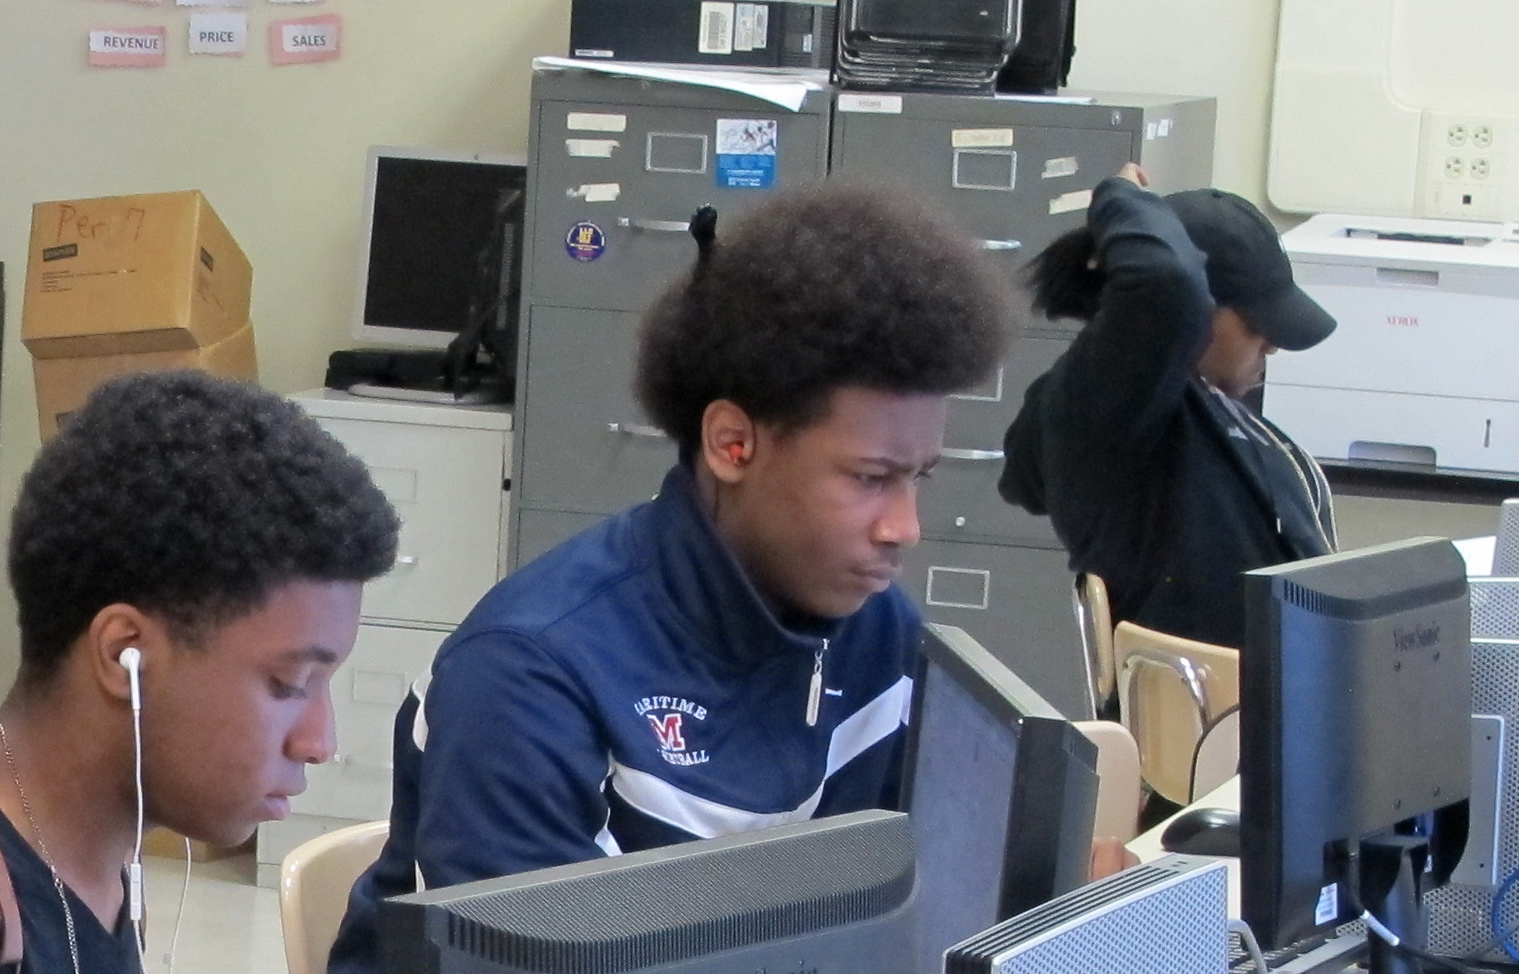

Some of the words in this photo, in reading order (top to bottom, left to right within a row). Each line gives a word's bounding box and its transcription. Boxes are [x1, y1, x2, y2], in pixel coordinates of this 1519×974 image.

[103, 36, 160, 49] REVENUE
[199, 31, 234, 43] PRICE
[292, 35, 326, 47] SALES
